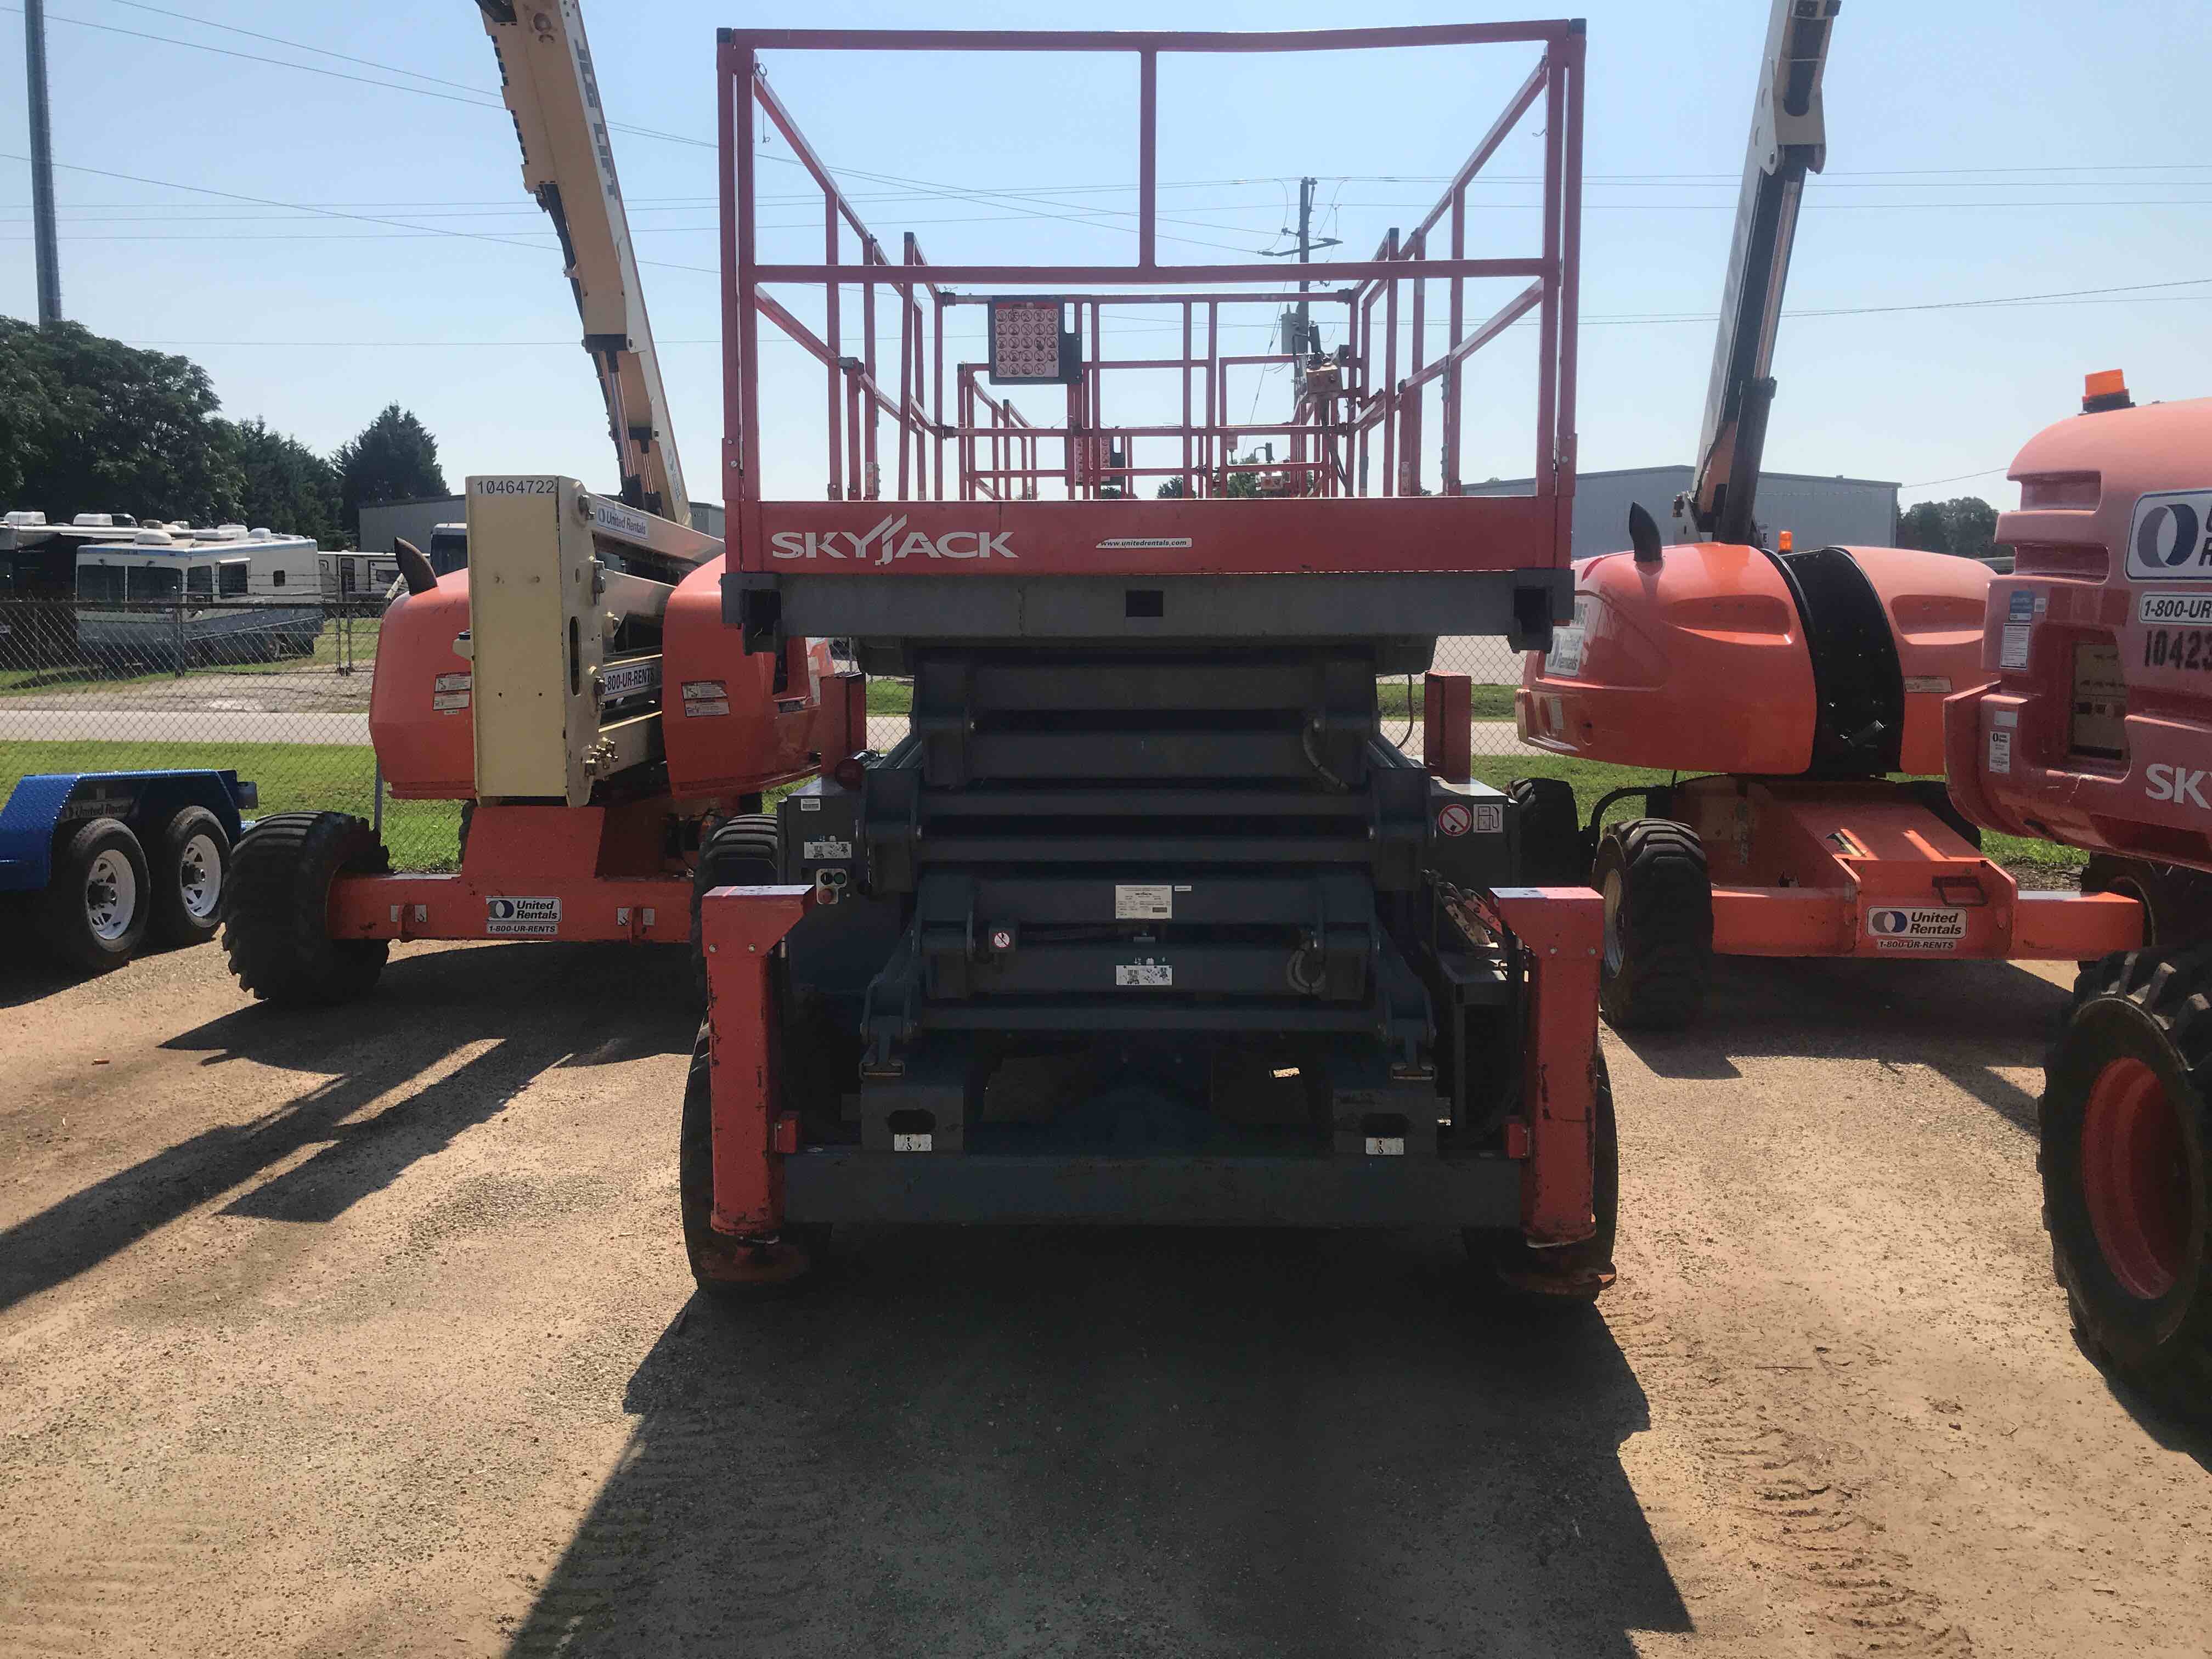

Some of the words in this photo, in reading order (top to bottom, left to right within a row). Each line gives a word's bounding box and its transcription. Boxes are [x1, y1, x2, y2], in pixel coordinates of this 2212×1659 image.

[593, 123, 618, 200] LIFT
[477, 480, 555, 494] 10464722
[606, 511, 626, 528] United
[627, 518, 646, 535] Rentals
[771, 514, 1019, 566] SKYJACK
[1101, 539, 1187, 547] www.unitedrentals.com
[2144, 600, 2212, 618] 1-800-UR
[2146, 763, 2212, 809] SK
[516, 900, 554, 910] United
[516, 910, 558, 919] Rentals
[1911, 912, 1959, 923] United
[1910, 923, 1962, 935] Rentals
[1879, 940, 1954, 949] 1-800-UR-RENTS
